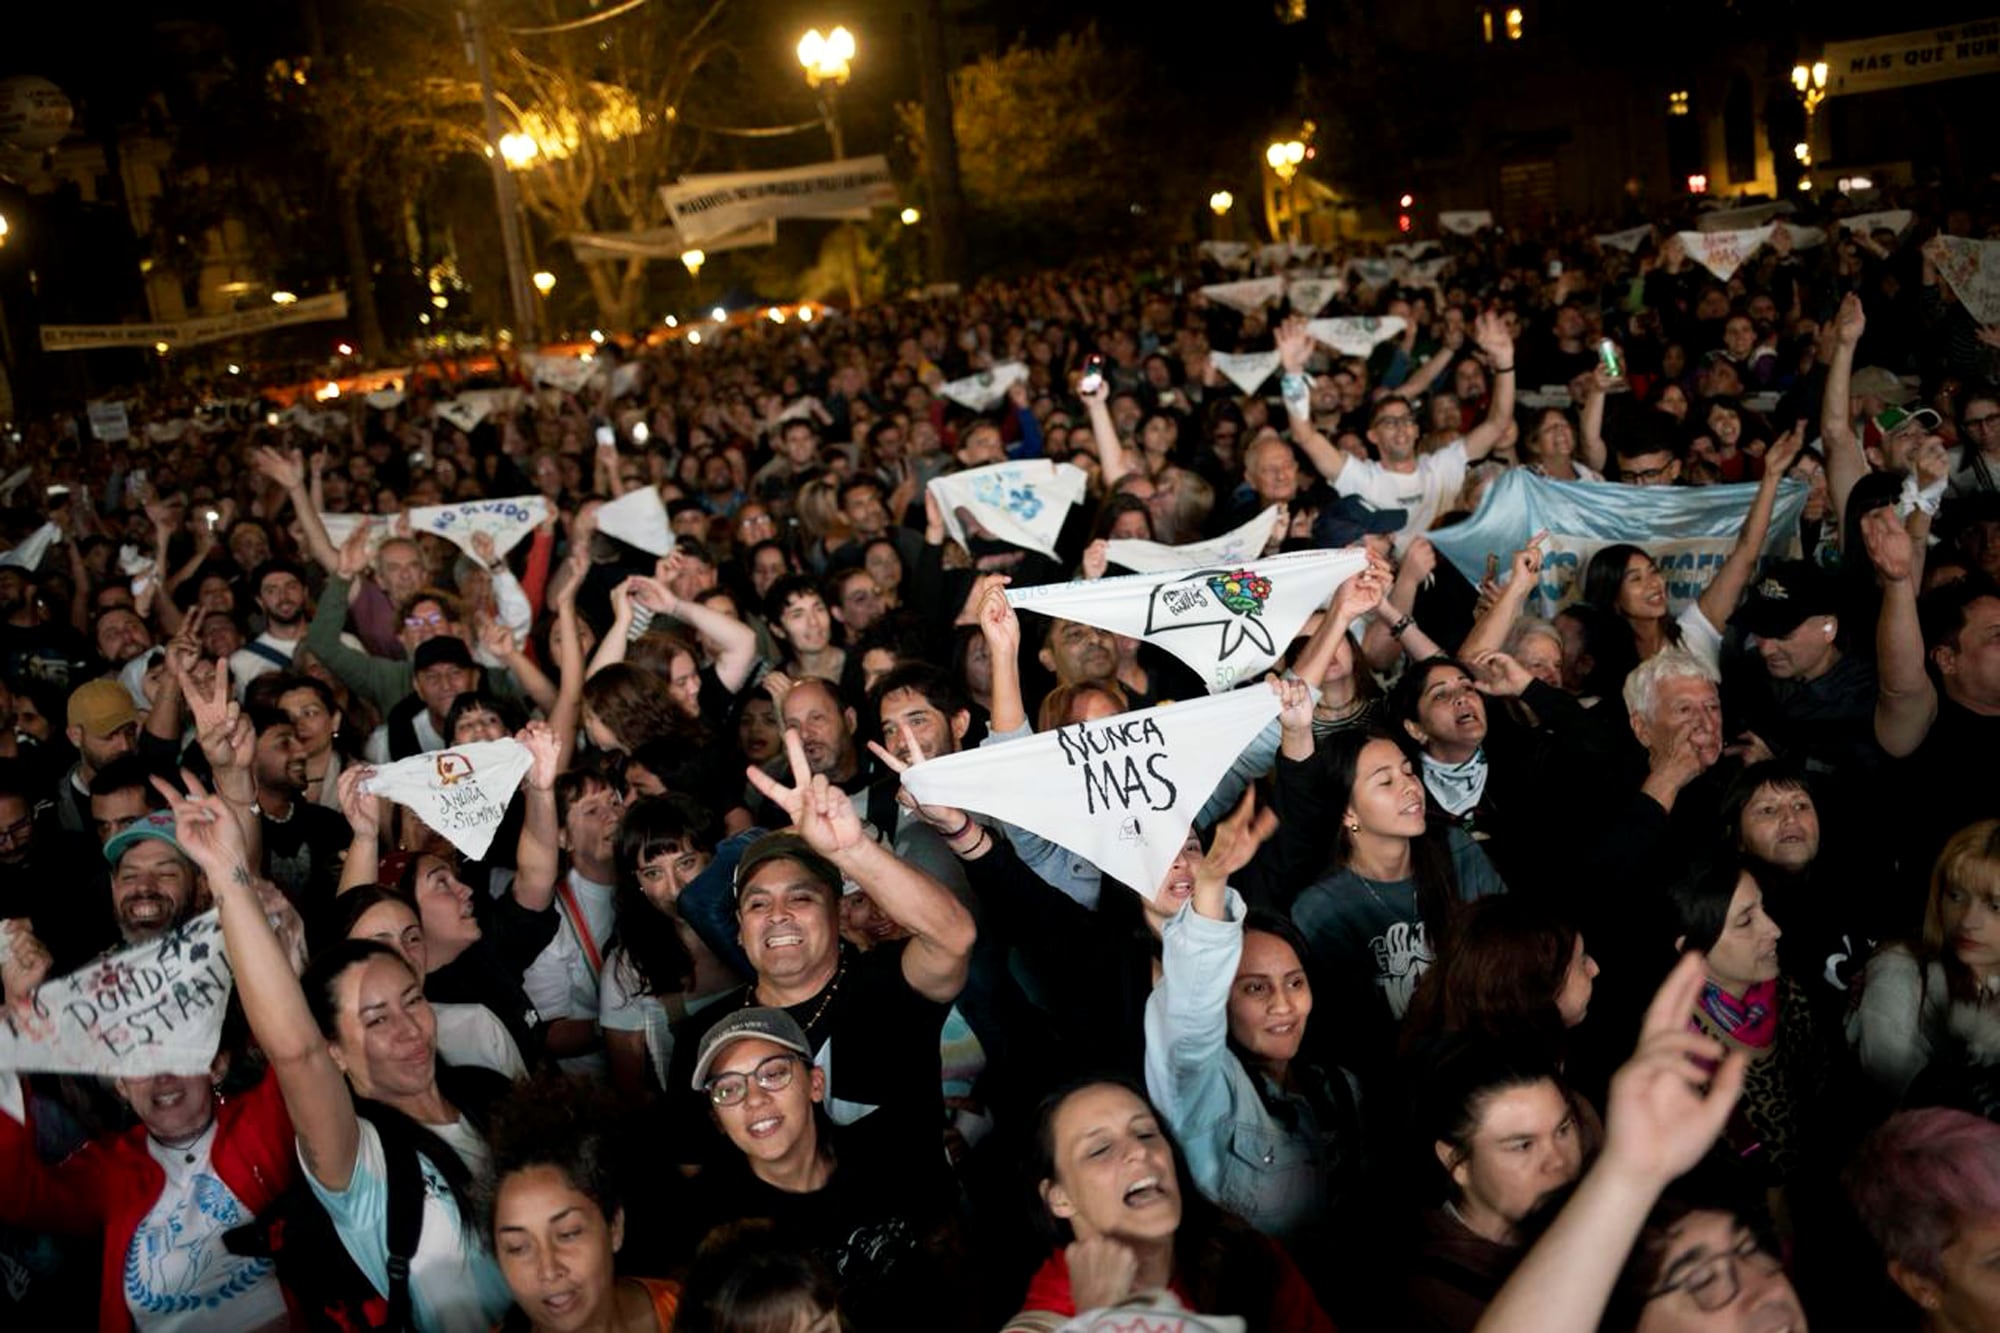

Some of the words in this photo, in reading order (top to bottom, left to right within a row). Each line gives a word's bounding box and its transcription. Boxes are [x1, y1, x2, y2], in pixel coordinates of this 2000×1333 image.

[1904, 47, 1945, 65] QUE
[1216, 666, 1235, 685] 50
[1056, 717, 1165, 765] NUNCA
[1083, 753, 1177, 814] MAS
[63, 952, 182, 1031] DONDE
